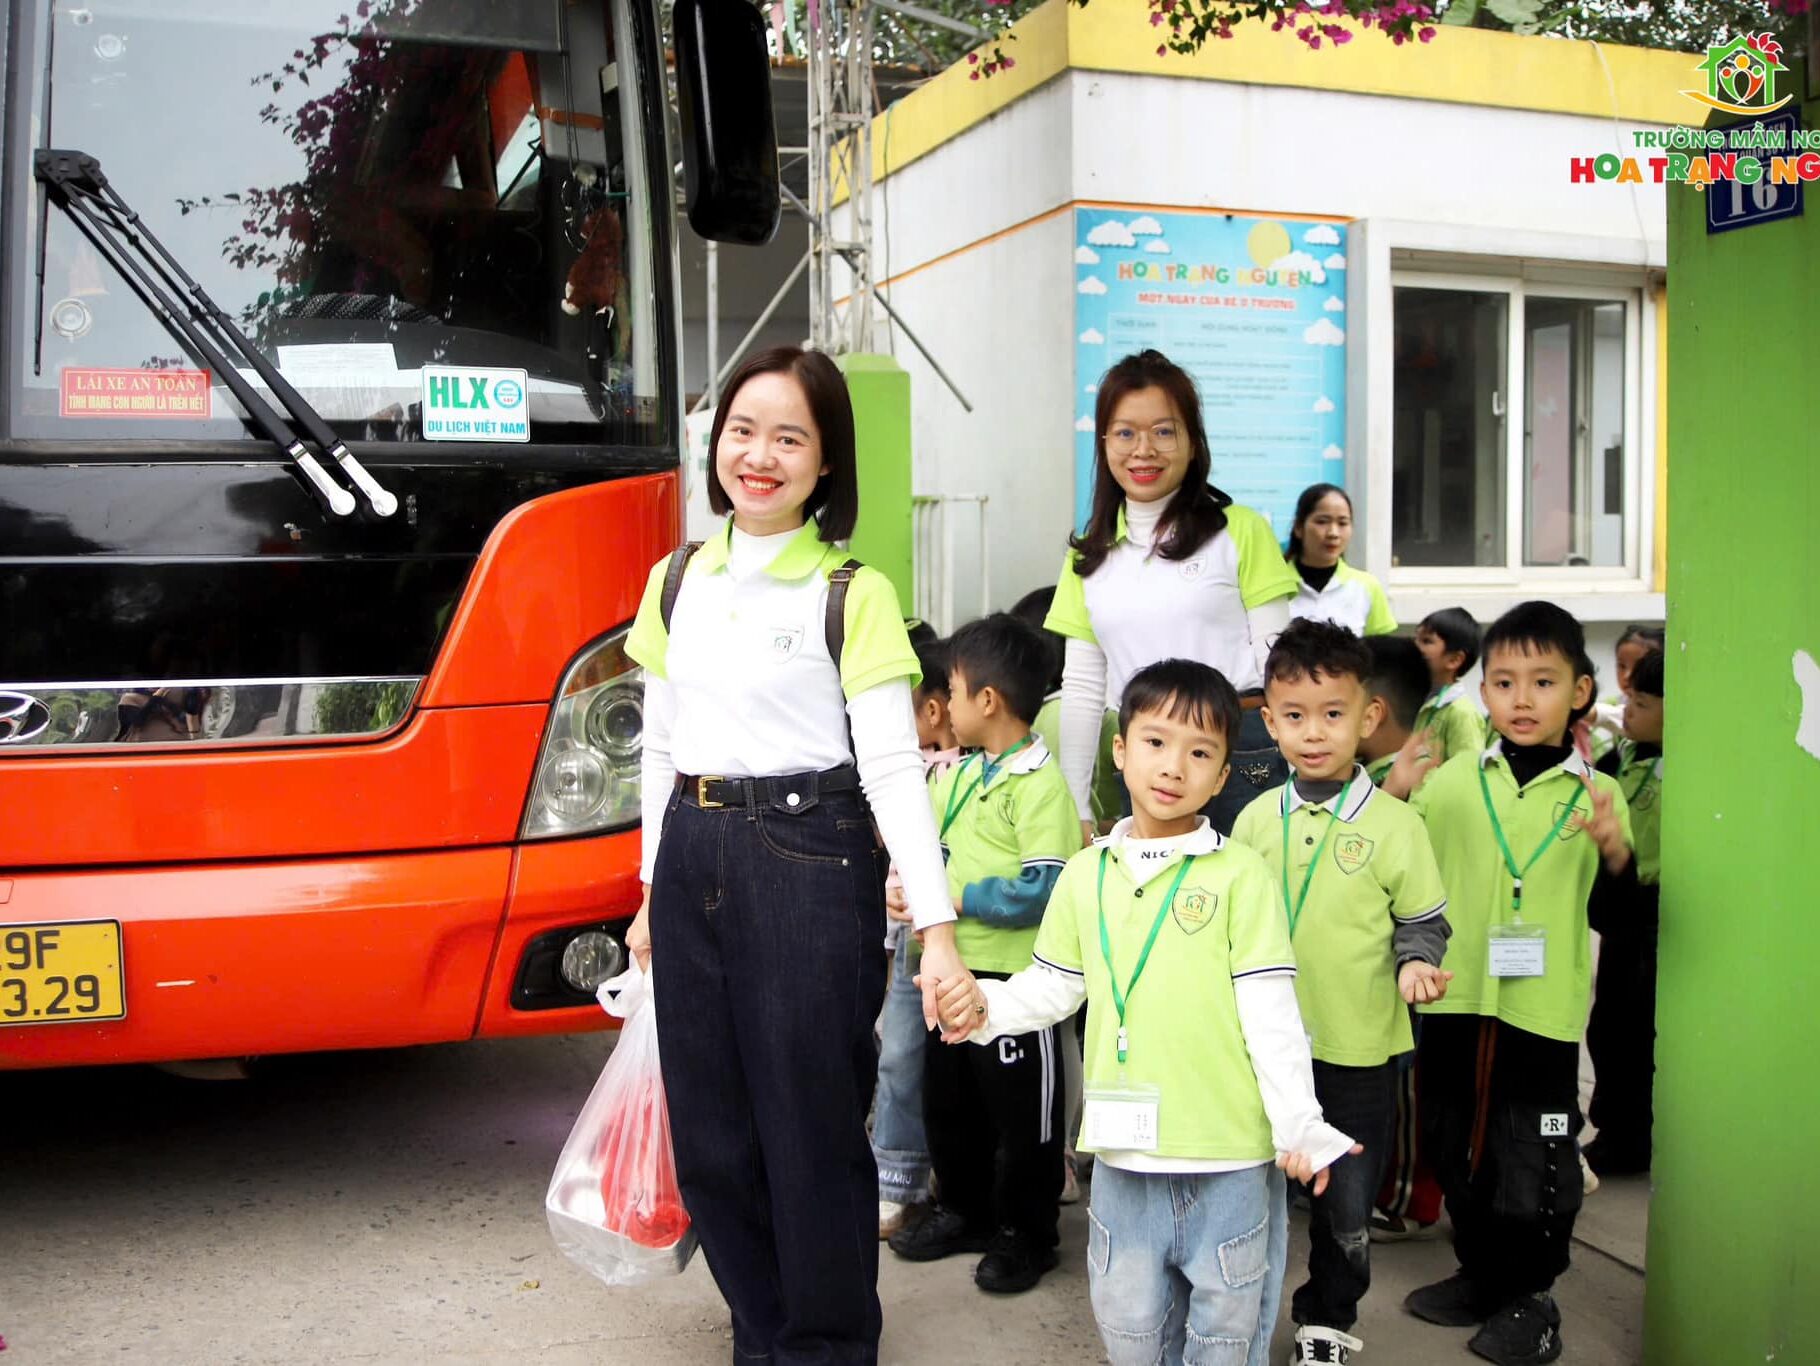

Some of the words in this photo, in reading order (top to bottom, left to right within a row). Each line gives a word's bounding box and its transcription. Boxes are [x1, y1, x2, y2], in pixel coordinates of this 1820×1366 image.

[1728, 167, 1778, 217] 16
[106, 377, 125, 390] XE
[131, 377, 150, 391] AN
[429, 376, 490, 409] HLX
[428, 420, 442, 432] DU
[500, 422, 526, 434] NAM
[1141, 849, 1175, 859] NIC
[0, 930, 60, 970] 9F
